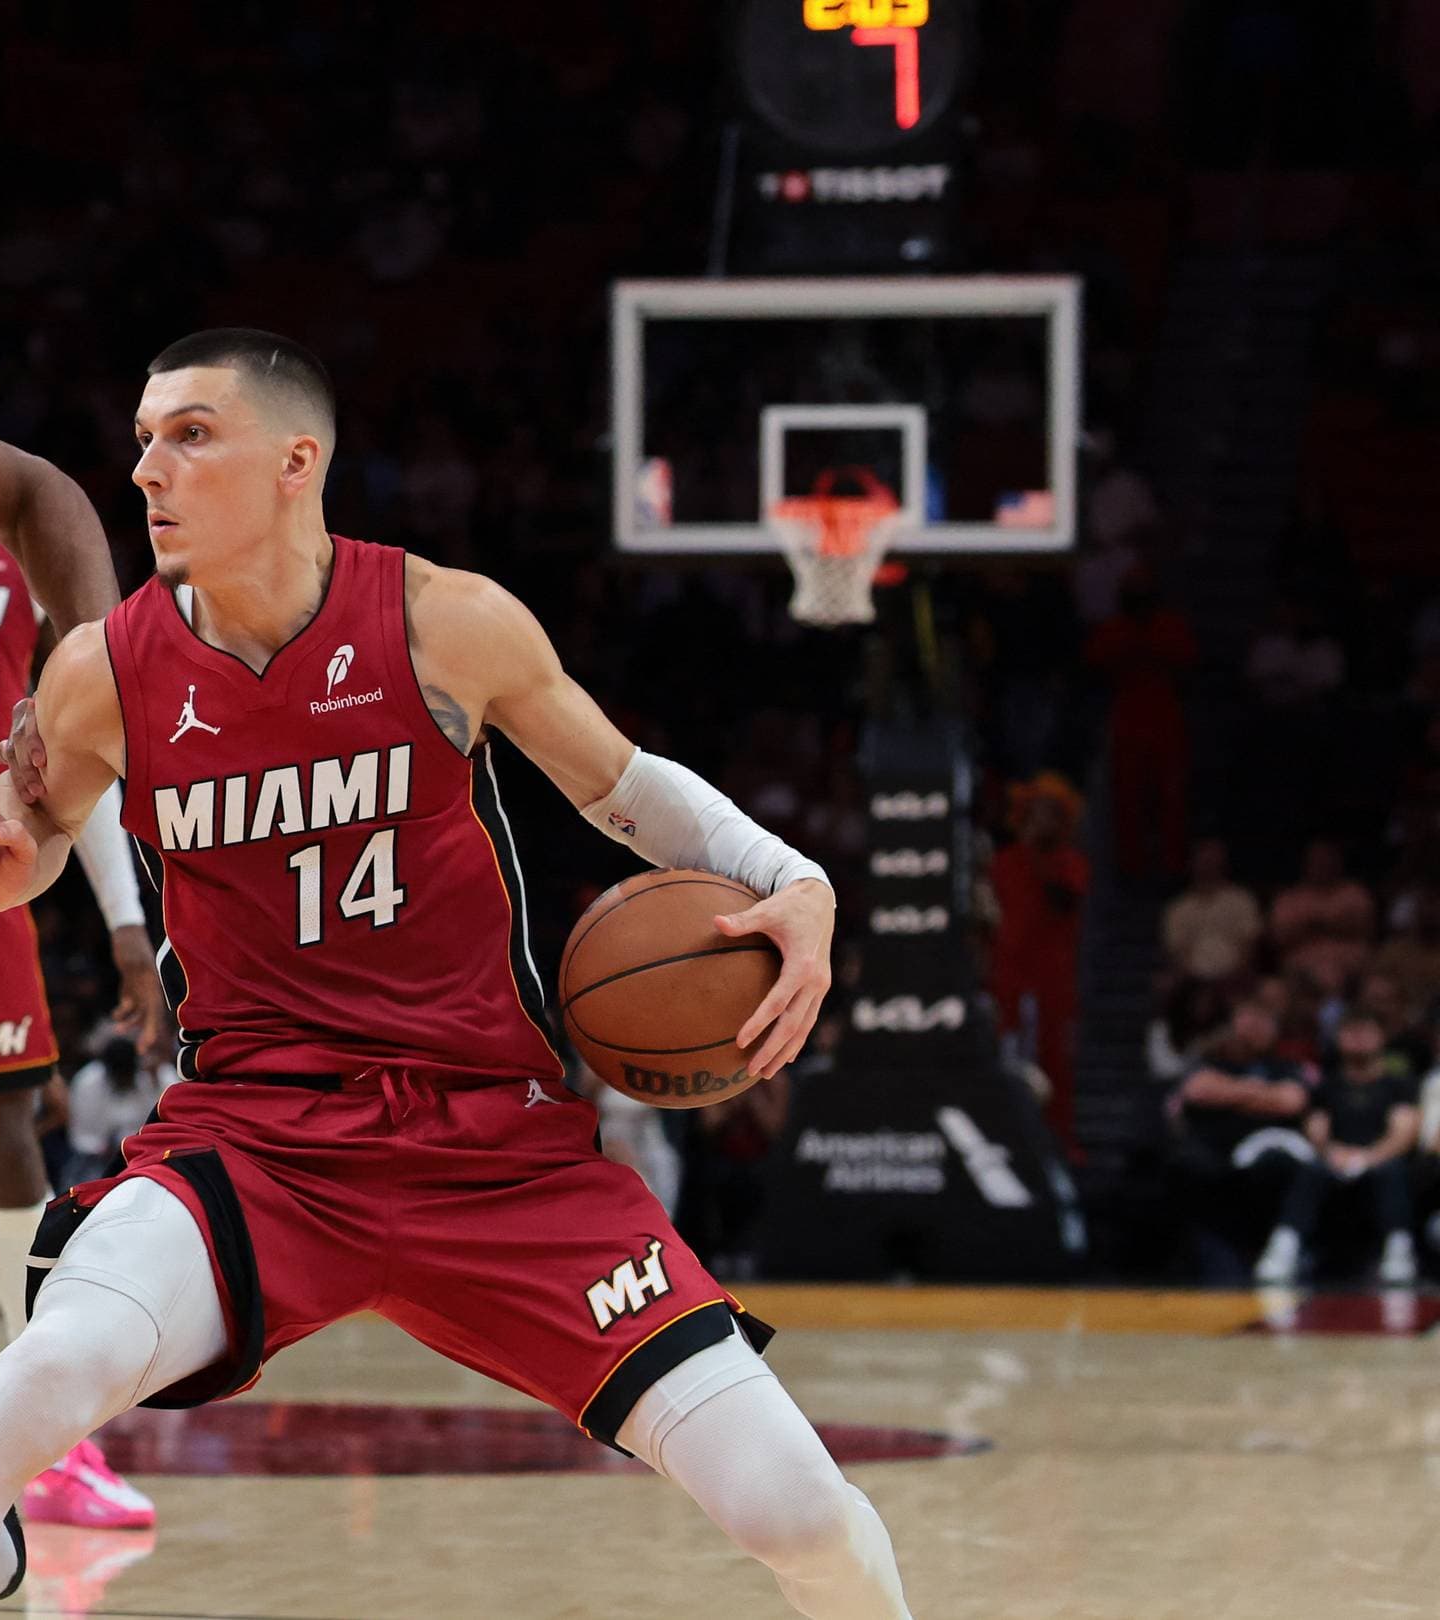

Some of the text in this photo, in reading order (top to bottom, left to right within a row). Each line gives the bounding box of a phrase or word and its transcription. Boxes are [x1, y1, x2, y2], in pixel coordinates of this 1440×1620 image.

[850, 27, 920, 130] 7
[309, 687, 384, 716] Robinhood
[154, 744, 413, 852] MIAMI
[288, 828, 406, 946] 14
[620, 1060, 748, 1097] Wilso
